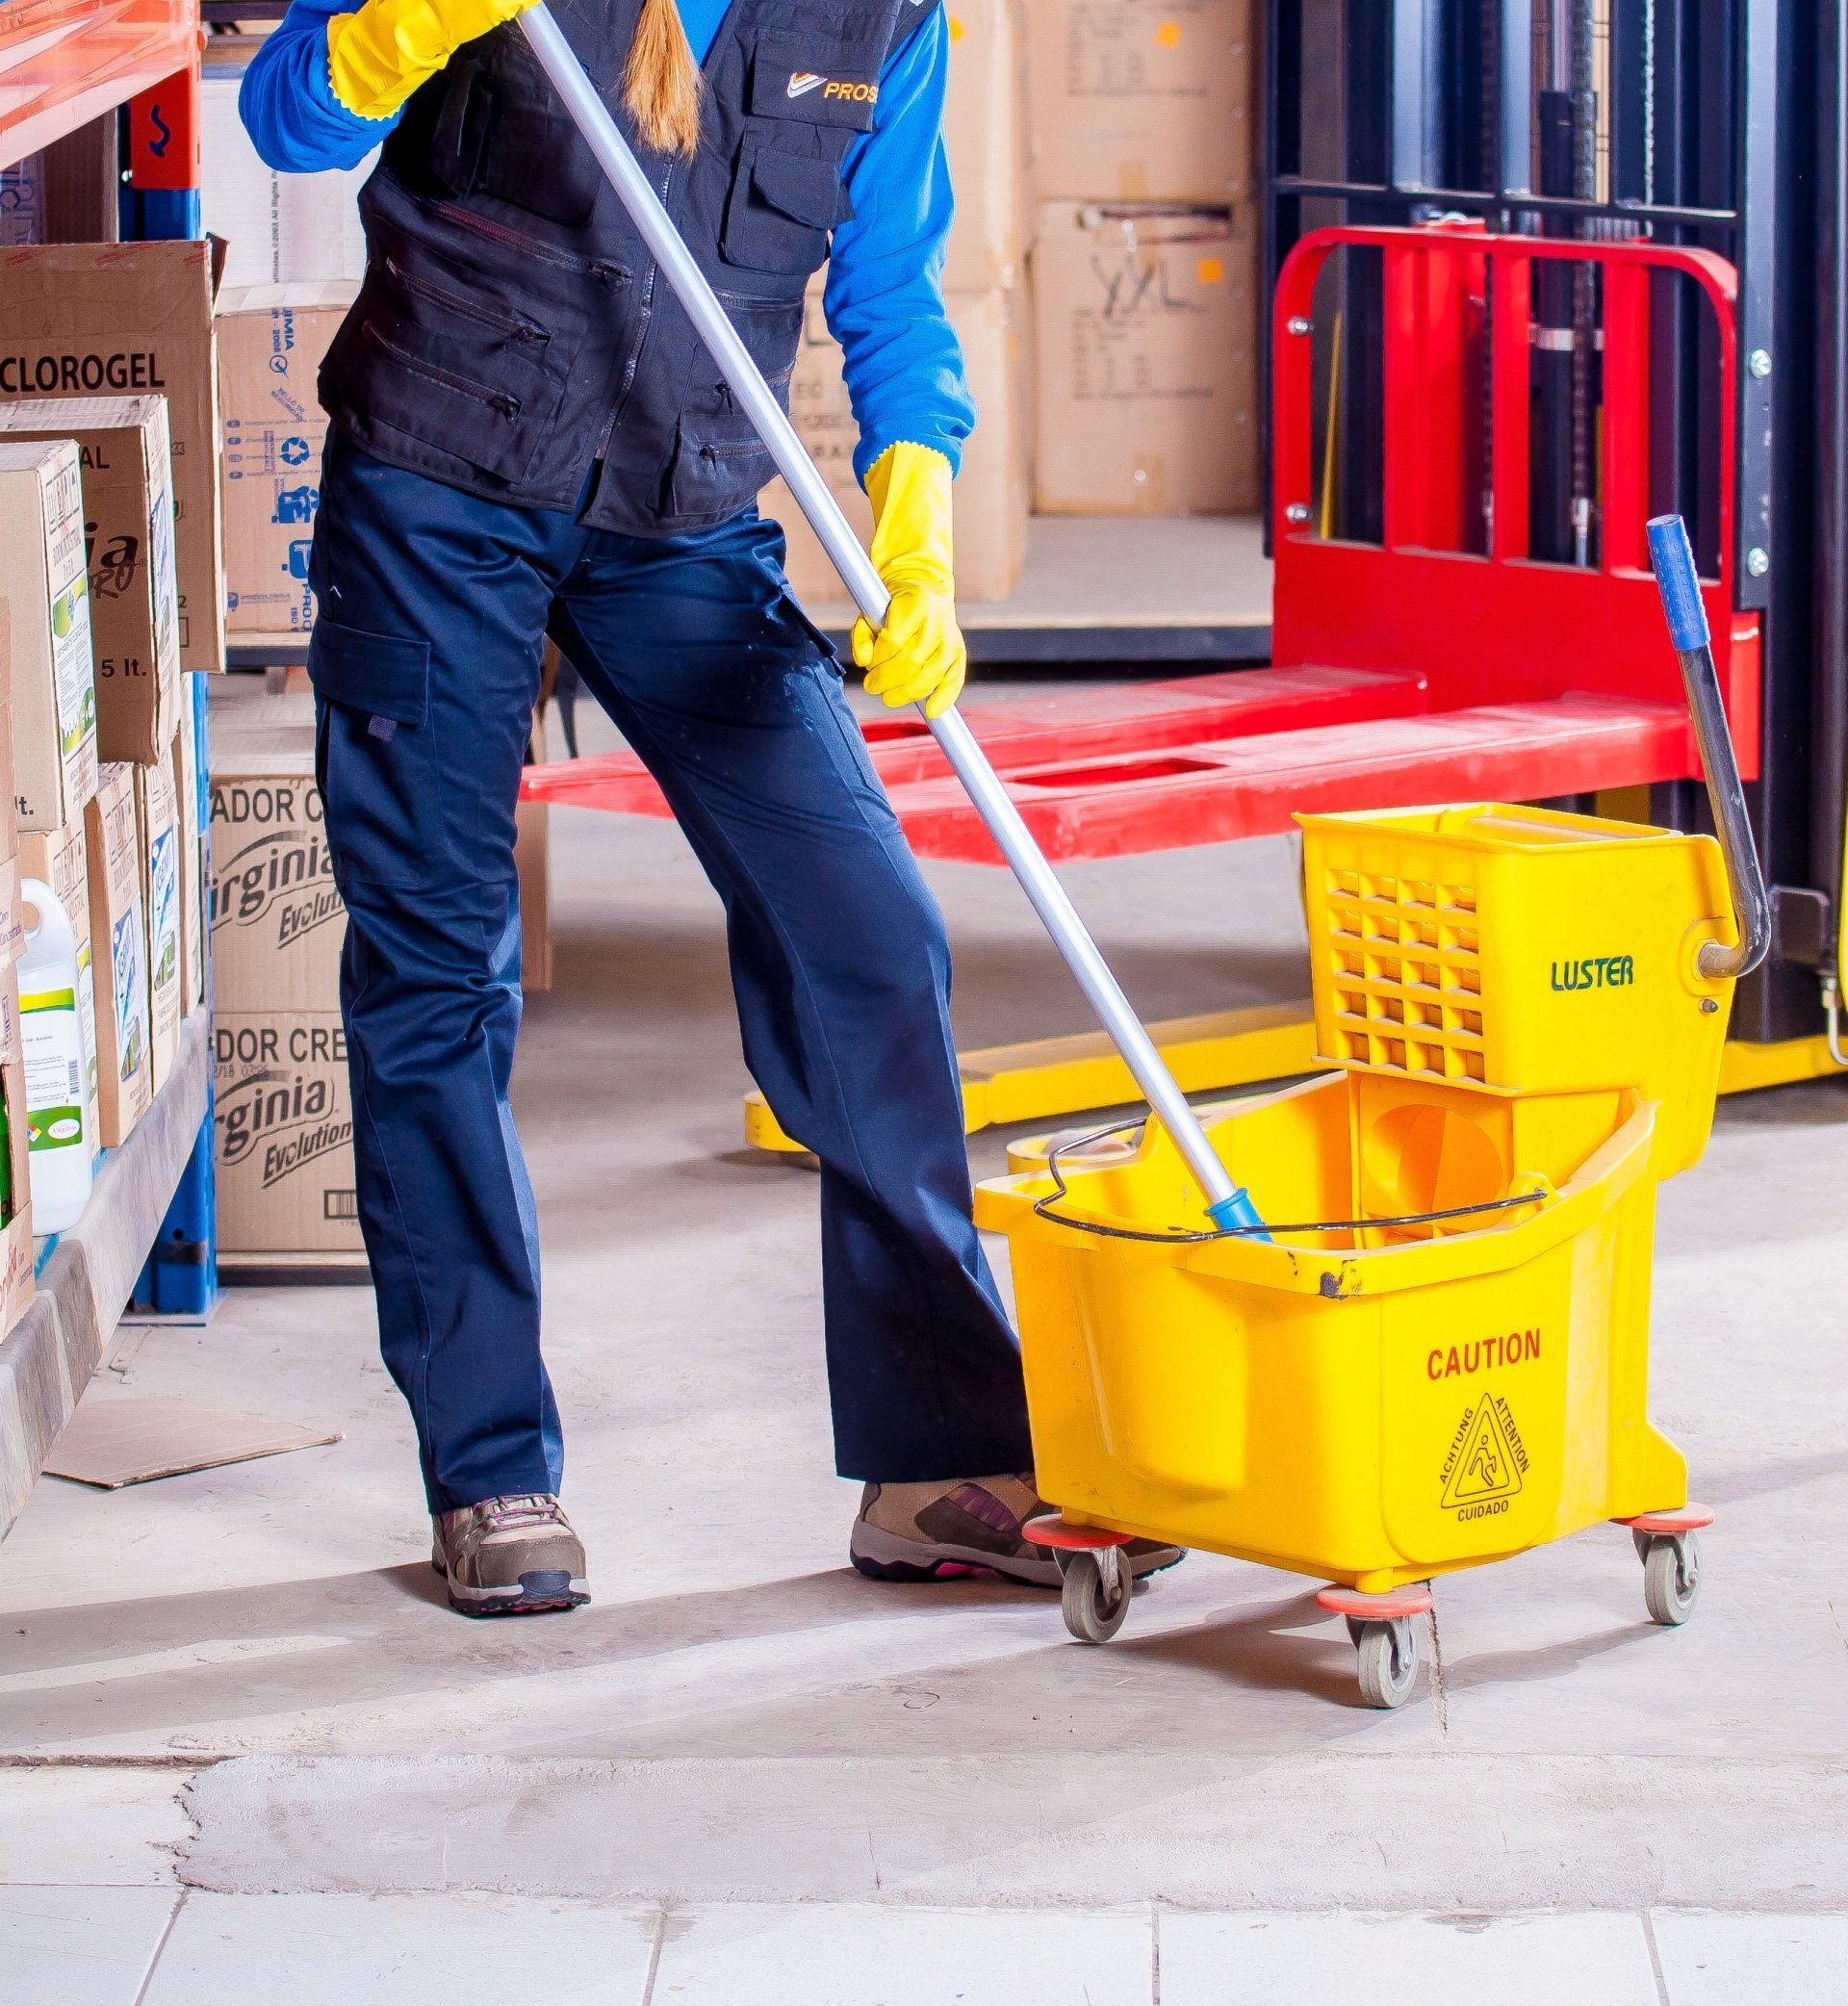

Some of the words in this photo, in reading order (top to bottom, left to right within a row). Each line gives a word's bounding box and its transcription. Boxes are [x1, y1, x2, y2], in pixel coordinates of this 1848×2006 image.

[0, 352, 166, 393] CLOROGEL
[101, 658, 116, 678] 5
[124, 657, 146, 677] lt.
[1551, 955, 1633, 991] LUSTER
[216, 1028, 279, 1063] DOR
[264, 1121, 352, 1182] Evolution
[1427, 1328, 1540, 1380] CAUTION
[1439, 1407, 1474, 1484] ACHTUNG
[1495, 1397, 1530, 1474] ATTENTION
[1457, 1500, 1509, 1522] CUIDADO
